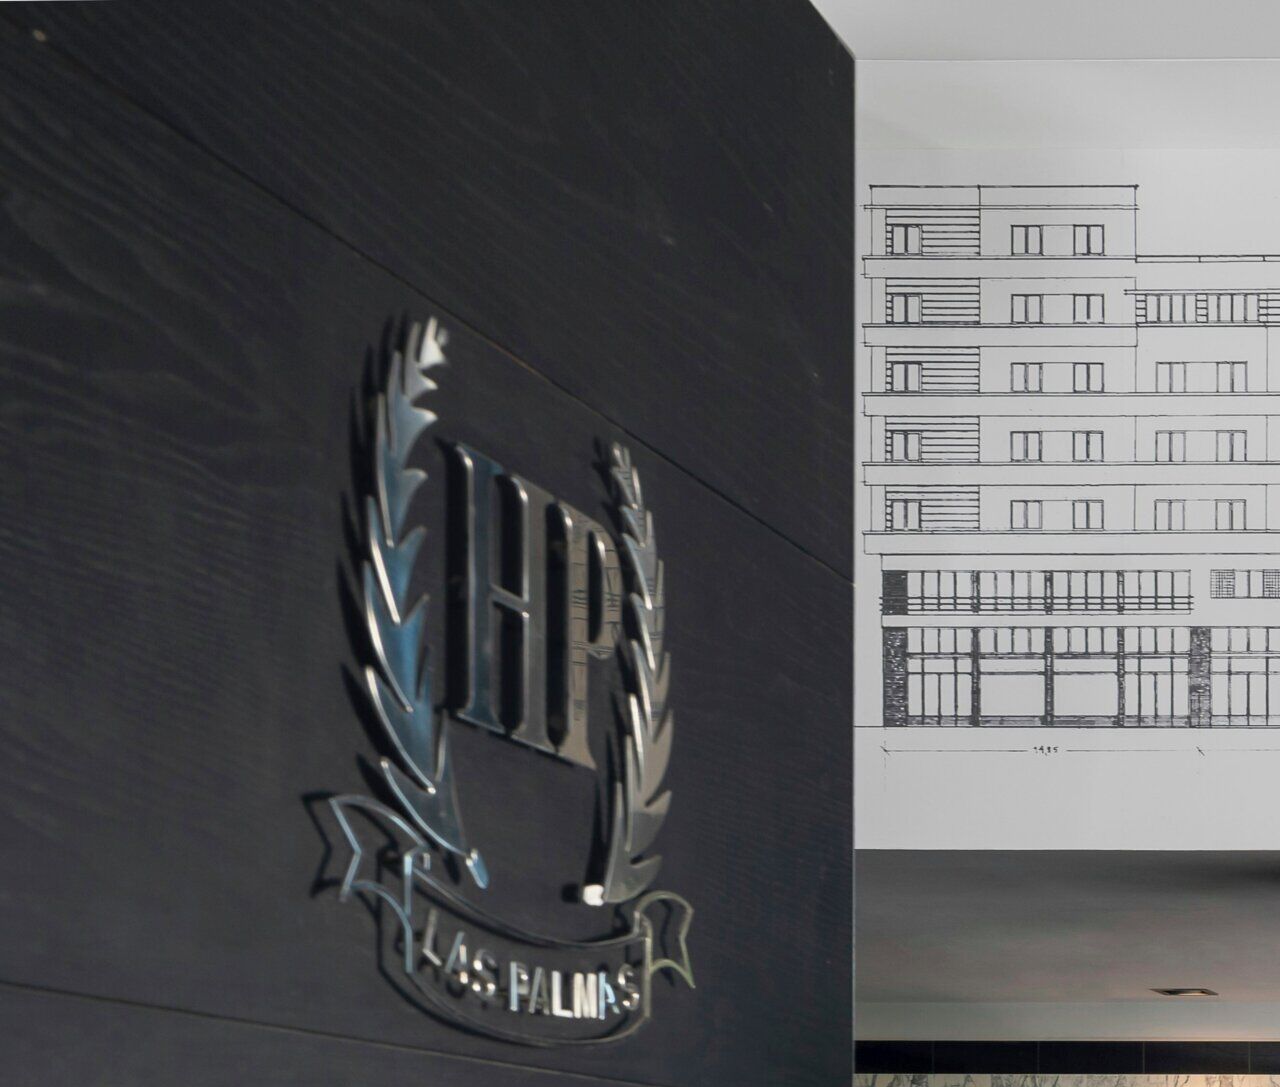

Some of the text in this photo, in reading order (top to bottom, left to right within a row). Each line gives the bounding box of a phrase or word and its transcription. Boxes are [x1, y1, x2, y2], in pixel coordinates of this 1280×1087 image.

[456, 442, 622, 770] HP
[422, 907, 640, 1020] LAS PALMAS
